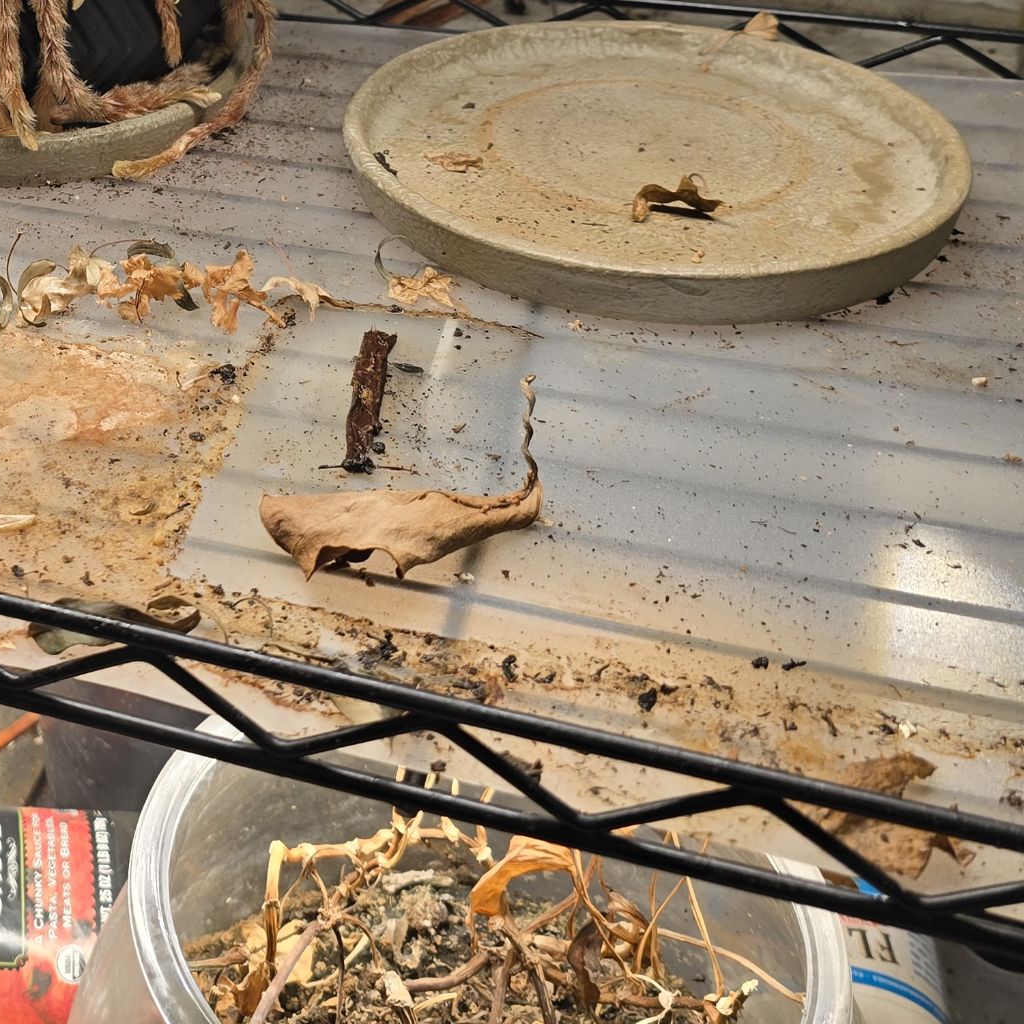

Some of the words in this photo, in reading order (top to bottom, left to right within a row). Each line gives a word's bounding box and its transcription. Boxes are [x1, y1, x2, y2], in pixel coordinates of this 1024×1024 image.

[33, 830, 43, 870] SAUCE
[59, 821, 70, 857] BREAD
[62, 860, 71, 877] OR
[34, 870, 44, 928] CHUNKY
[47, 892, 58, 939] PASTA,
[62, 882, 72, 928] MEATS
[99, 889, 113, 903] 25
